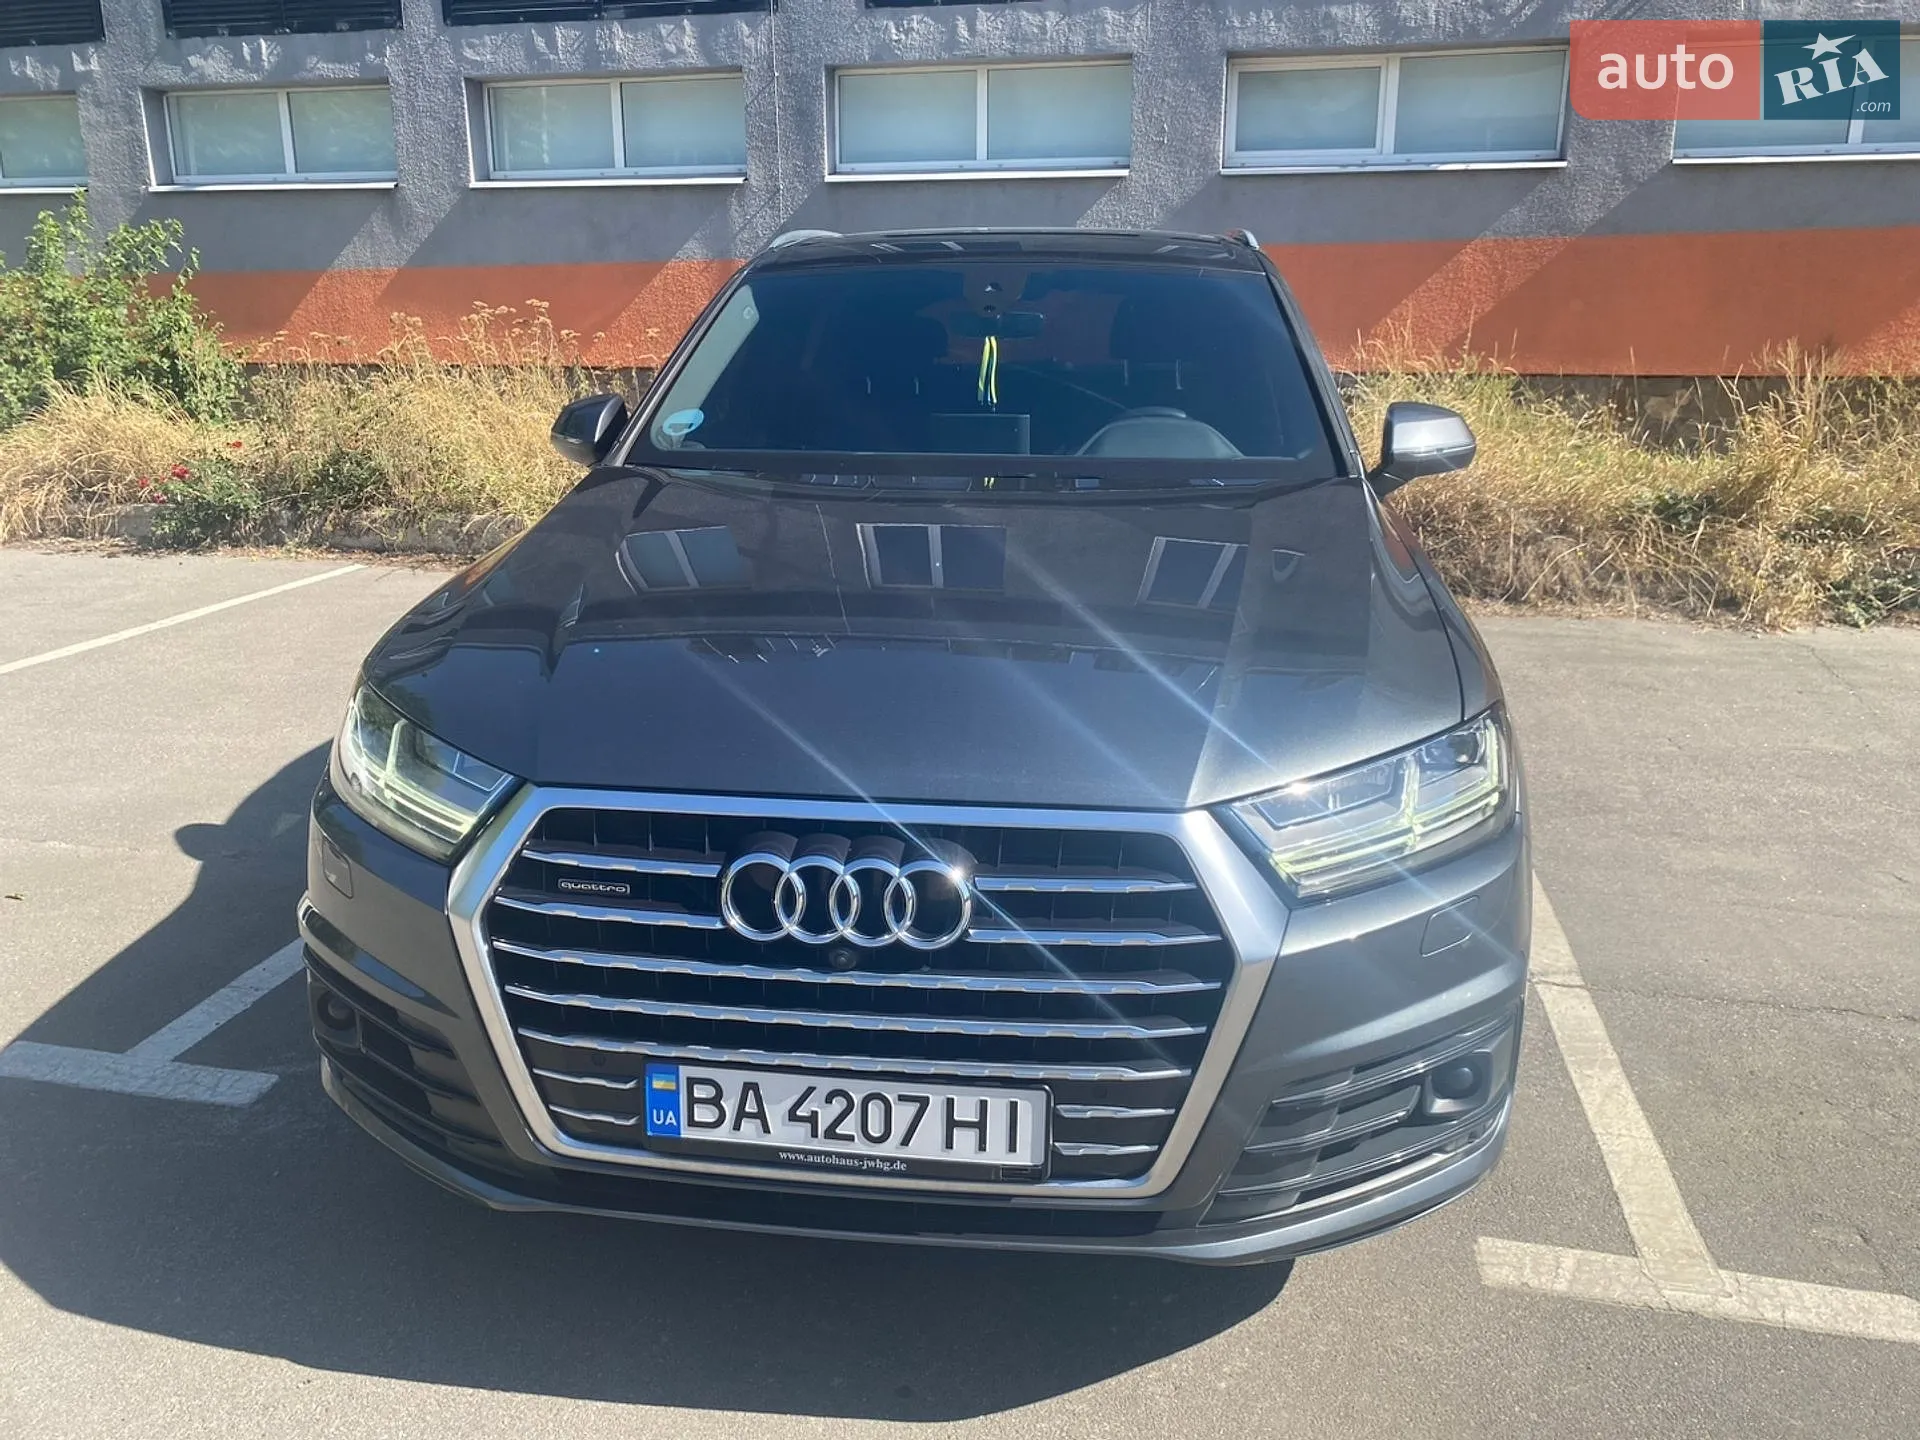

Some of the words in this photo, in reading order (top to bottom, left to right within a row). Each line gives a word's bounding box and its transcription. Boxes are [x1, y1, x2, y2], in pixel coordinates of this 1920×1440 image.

[561, 881, 626, 892] quattro
[652, 1110, 678, 1126] UA
[686, 1076, 772, 1135] BA
[787, 1086, 931, 1147] 4207
[945, 1096, 1019, 1153] HI
[778, 1151, 908, 1172] www.autohaus-jwhg.de
